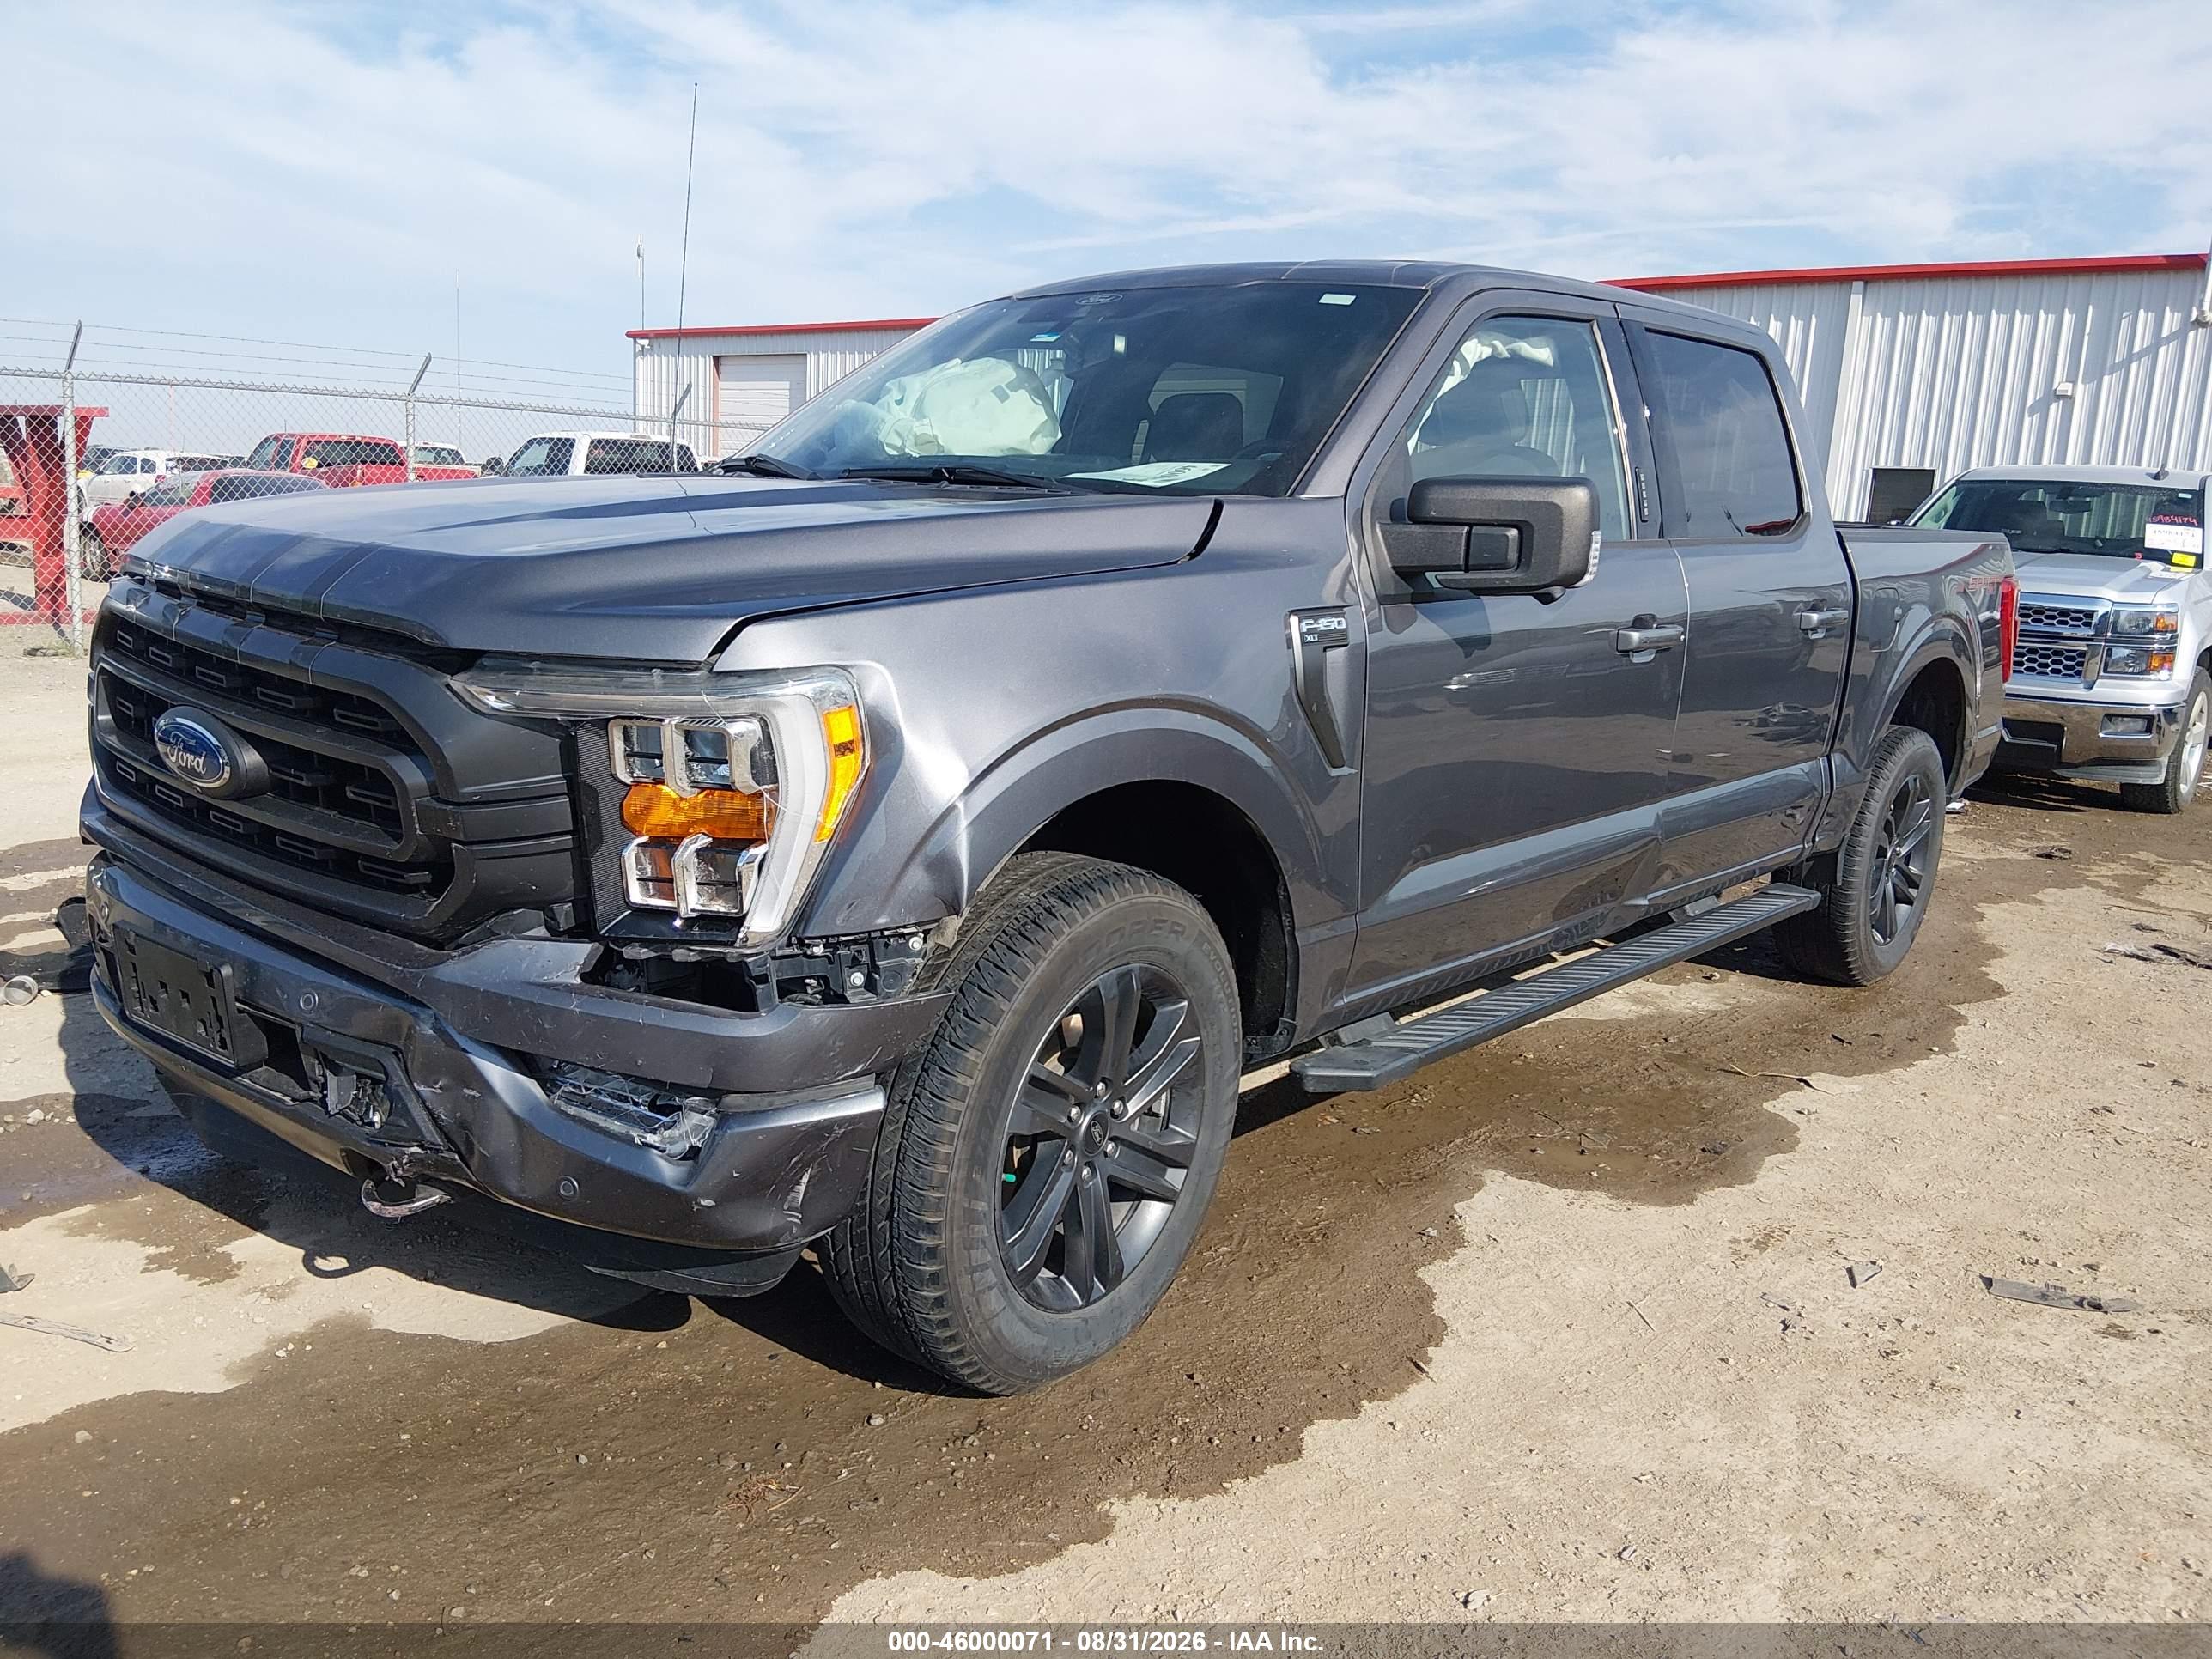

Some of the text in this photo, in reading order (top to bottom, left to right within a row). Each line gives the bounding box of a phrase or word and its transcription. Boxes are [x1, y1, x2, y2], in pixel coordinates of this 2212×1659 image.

[1300, 617, 1346, 633] F-150
[1304, 634, 1319, 642] XLT
[166, 731, 207, 775] Ford
[1202, 941, 1239, 1042] EVOLUTION
